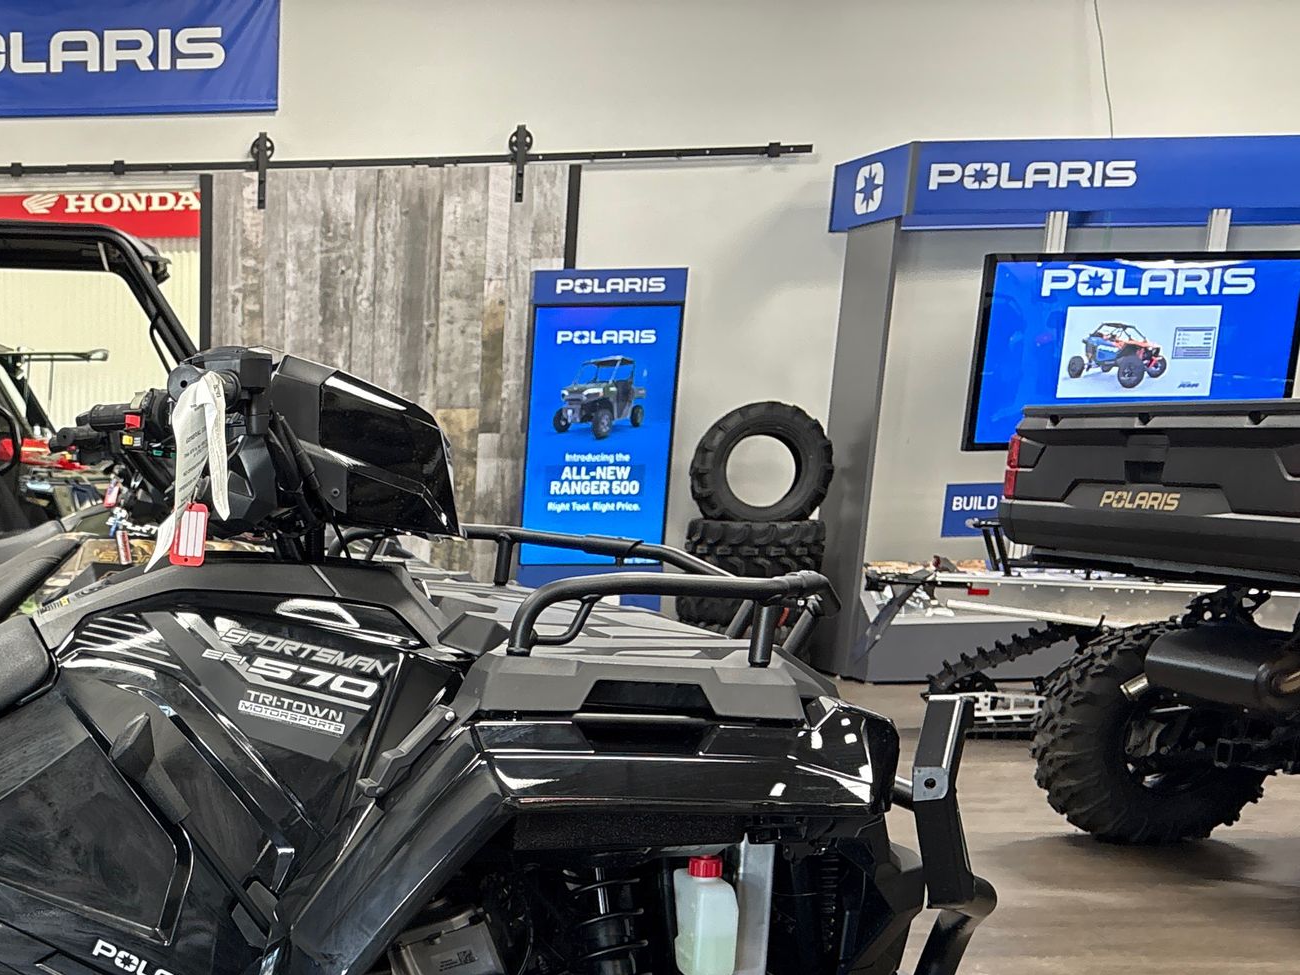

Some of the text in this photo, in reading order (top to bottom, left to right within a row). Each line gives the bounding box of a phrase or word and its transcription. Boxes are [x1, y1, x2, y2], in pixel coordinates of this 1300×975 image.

[928, 160, 1138, 191] POLARIS
[64, 191, 201, 214] HONDA
[555, 277, 666, 295] POLARIS
[1041, 267, 1256, 297] POLARIS
[556, 329, 657, 345] POLARIS
[565, 453, 631, 464] Introducing the
[561, 466, 631, 480] ALL-NEW
[549, 481, 610, 495] RANGER
[547, 501, 570, 513] Right
[592, 501, 615, 513] Right
[951, 495, 998, 512] BUILD
[1099, 490, 1182, 511] POLARIS
[220, 628, 399, 677] SPORTSMAN
[202, 649, 380, 699] EFI 570
[247, 690, 343, 722] TRI-TOWN
[239, 701, 345, 734] MOTORSPORTS
